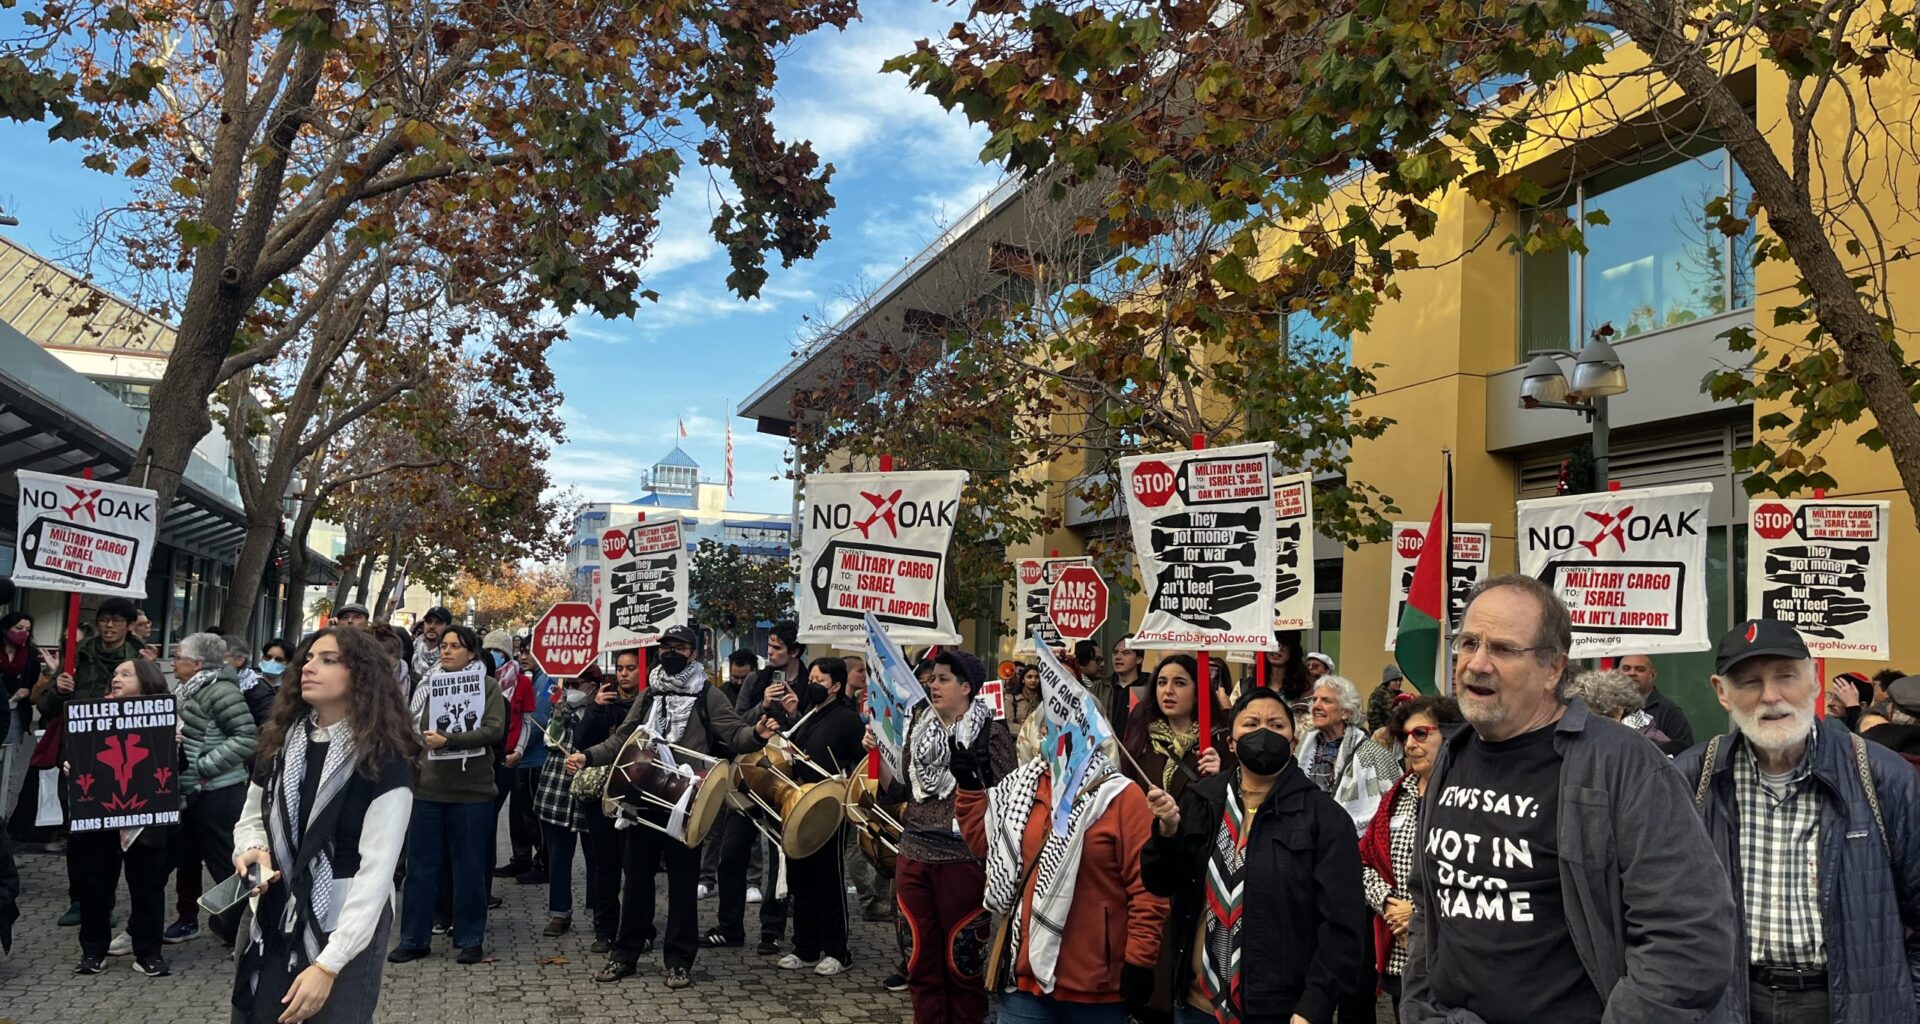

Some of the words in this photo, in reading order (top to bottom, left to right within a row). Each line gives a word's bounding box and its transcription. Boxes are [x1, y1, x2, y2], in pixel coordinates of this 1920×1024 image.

[1194, 464, 1232, 476] MILITARY
[1235, 462, 1262, 474] CARGO
[1133, 474, 1173, 494] STOP
[1209, 476, 1244, 486] ISRAEL'S
[1198, 490, 1212, 499] OAK
[1214, 489, 1232, 498] INT'L
[1234, 486, 1264, 496] AIRPORT
[1283, 487, 1301, 497] CARGO
[23, 488, 58, 510] NO
[98, 498, 152, 522] OAK
[812, 504, 851, 530] NO
[899, 499, 958, 528] OAK
[1188, 512, 1217, 528] They
[1755, 513, 1792, 529] STOP
[1812, 510, 1846, 518] MILITARY
[1529, 526, 1574, 550] NO
[1628, 508, 1701, 541] OAK
[1824, 520, 1856, 528] ISRAEL'S
[1173, 529, 1190, 546] got
[1194, 530, 1235, 545] money
[1846, 530, 1872, 538] AIRPORT
[50, 528, 94, 550] MILITARY
[96, 539, 128, 556] CARGO
[604, 536, 626, 551] STOP
[1398, 536, 1424, 550] STOP
[62, 544, 93, 562] ISRAEL
[1184, 547, 1200, 561] for
[1204, 548, 1228, 561] war
[1807, 546, 1832, 558] They
[46, 556, 62, 568] OAK
[64, 558, 83, 574] INT'L
[86, 564, 122, 582] AIRPORT
[840, 554, 895, 575] MILITARY
[898, 560, 934, 580] CARGO
[1020, 566, 1040, 578] STOP
[1174, 565, 1194, 579] but
[1790, 560, 1808, 572] got
[1811, 560, 1848, 574] money
[638, 570, 662, 580] money
[1566, 572, 1624, 588] MILITARY
[1627, 574, 1670, 590] CARGO
[1800, 573, 1817, 584] for
[1819, 574, 1840, 585] war
[642, 582, 657, 591] war
[830, 583, 852, 592] FROM:
[840, 572, 852, 581] TO:
[857, 574, 896, 594] ISRAEL
[1056, 580, 1096, 600] ARMS
[1188, 580, 1213, 594] feed
[627, 594, 638, 604] but
[1566, 589, 1579, 597] TO:
[1584, 591, 1626, 606] ISRAEL
[1792, 586, 1810, 598] but
[616, 604, 634, 616] can't
[634, 602, 650, 614] feed
[839, 592, 859, 608] OAK
[862, 595, 884, 612] INT'L
[888, 599, 930, 618] AIRPORT
[1054, 599, 1096, 611] EMBARGO
[1160, 596, 1179, 610] the
[1182, 596, 1212, 612] poor.
[1773, 599, 1800, 610] can't
[1804, 600, 1828, 611] feed
[618, 616, 630, 626] the
[631, 614, 650, 626] poor.
[1058, 612, 1096, 628] NOW!
[1569, 611, 1586, 624] AK
[1589, 612, 1616, 625] INT'L
[1620, 612, 1669, 626] AIRPORT
[1777, 610, 1795, 622] the
[1798, 612, 1828, 624] poor.
[546, 616, 594, 634] ARMS
[542, 634, 593, 646] EMBARGO
[1138, 630, 1268, 646] ArmsEmbargoNow.org
[546, 649, 591, 665] NOW!
[432, 677, 456, 687] KILLER
[458, 674, 480, 684] CARGO
[432, 686, 449, 697] OUT
[451, 686, 462, 694] OF
[464, 682, 480, 692] OAK
[68, 702, 120, 719] KILLER
[124, 698, 174, 716] CARGO
[1048, 696, 1069, 720] FOR
[68, 719, 93, 733] OUT
[96, 718, 112, 731] OF
[116, 714, 176, 730] OAKLAND
[1482, 790, 1540, 818] SAY:
[70, 818, 102, 832] ARMS
[104, 813, 152, 828] EMBARGO
[155, 810, 180, 824] NOW
[1425, 828, 1481, 864] NOT
[1492, 837, 1534, 868] IN
[1437, 888, 1534, 922] NAME
